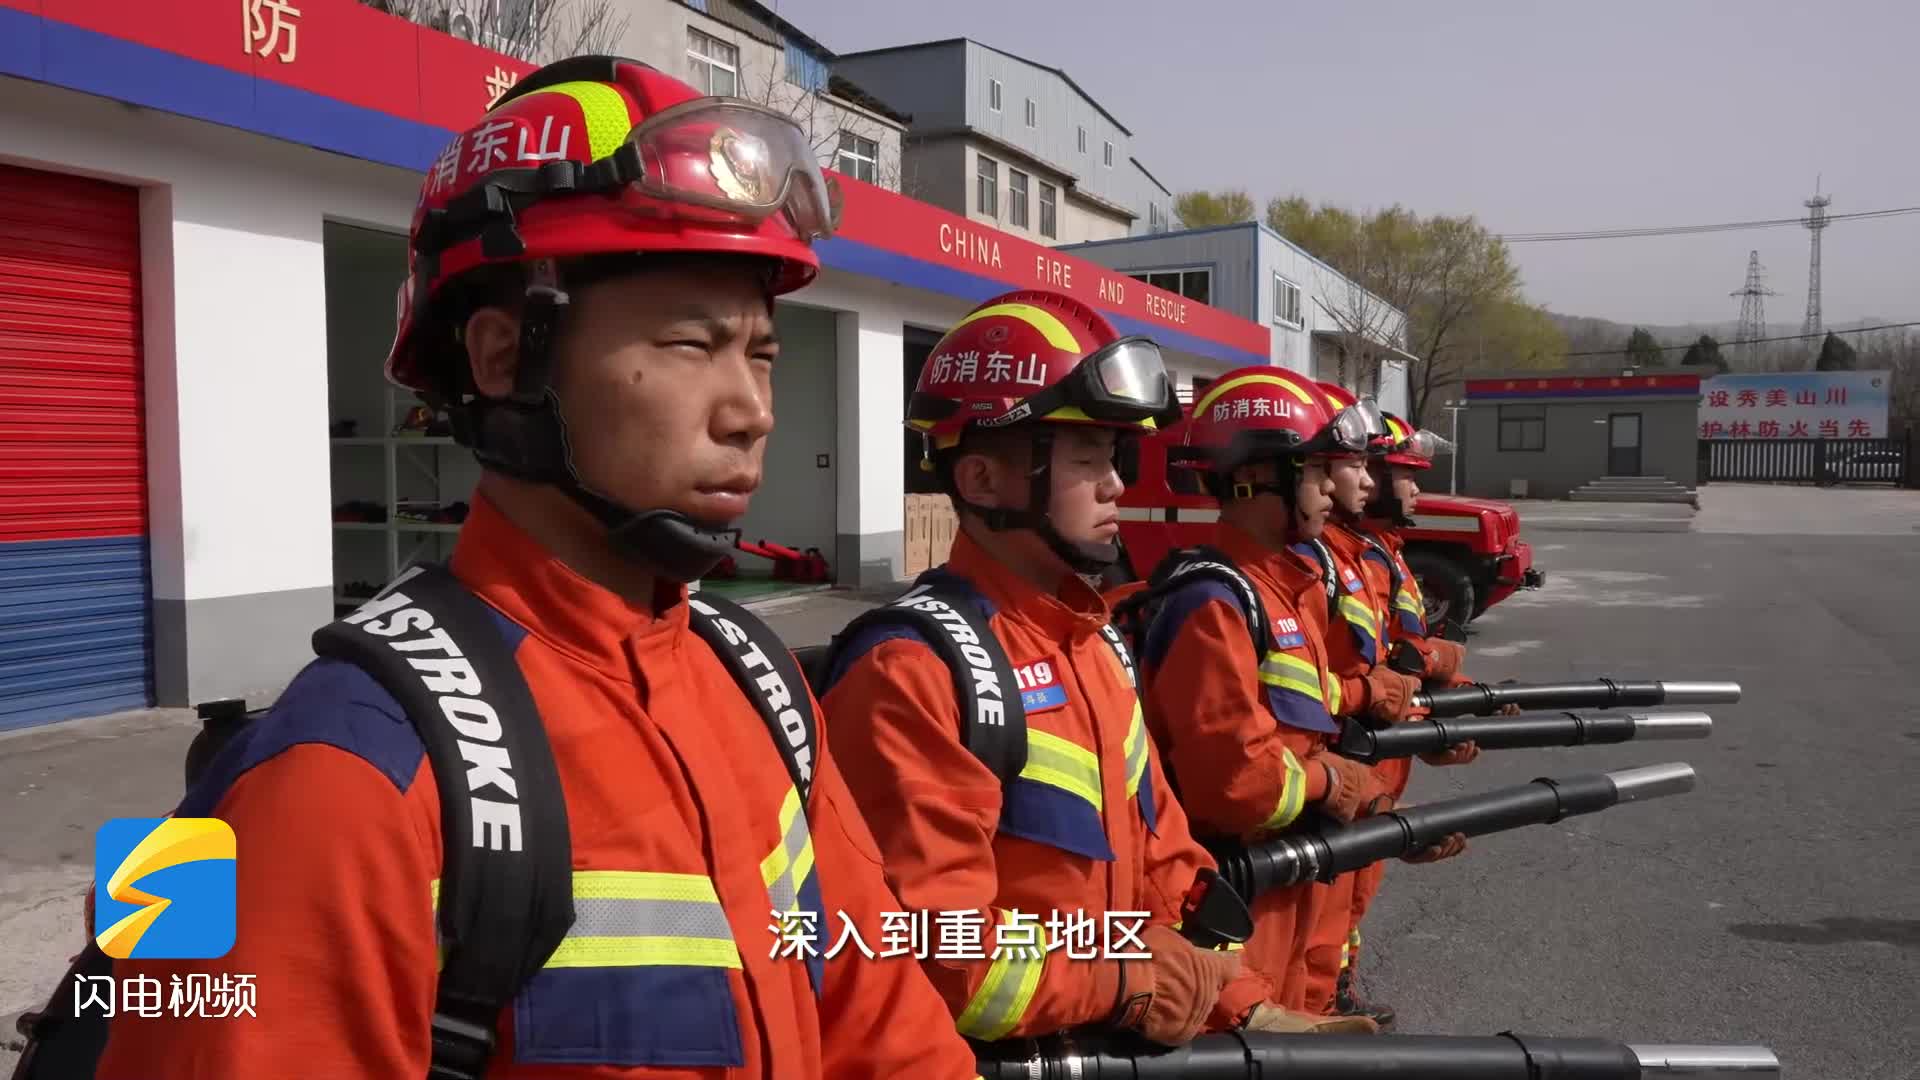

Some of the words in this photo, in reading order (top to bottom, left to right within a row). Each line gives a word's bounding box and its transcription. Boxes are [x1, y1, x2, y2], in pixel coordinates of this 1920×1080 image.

[419, 115, 571, 208] 消东山
[939, 223, 1001, 268] CHINA
[1037, 256, 1072, 288] FIRE
[1099, 279, 1124, 305] AND
[1146, 294, 1185, 324] RESCUE
[1277, 618, 1297, 633] 119
